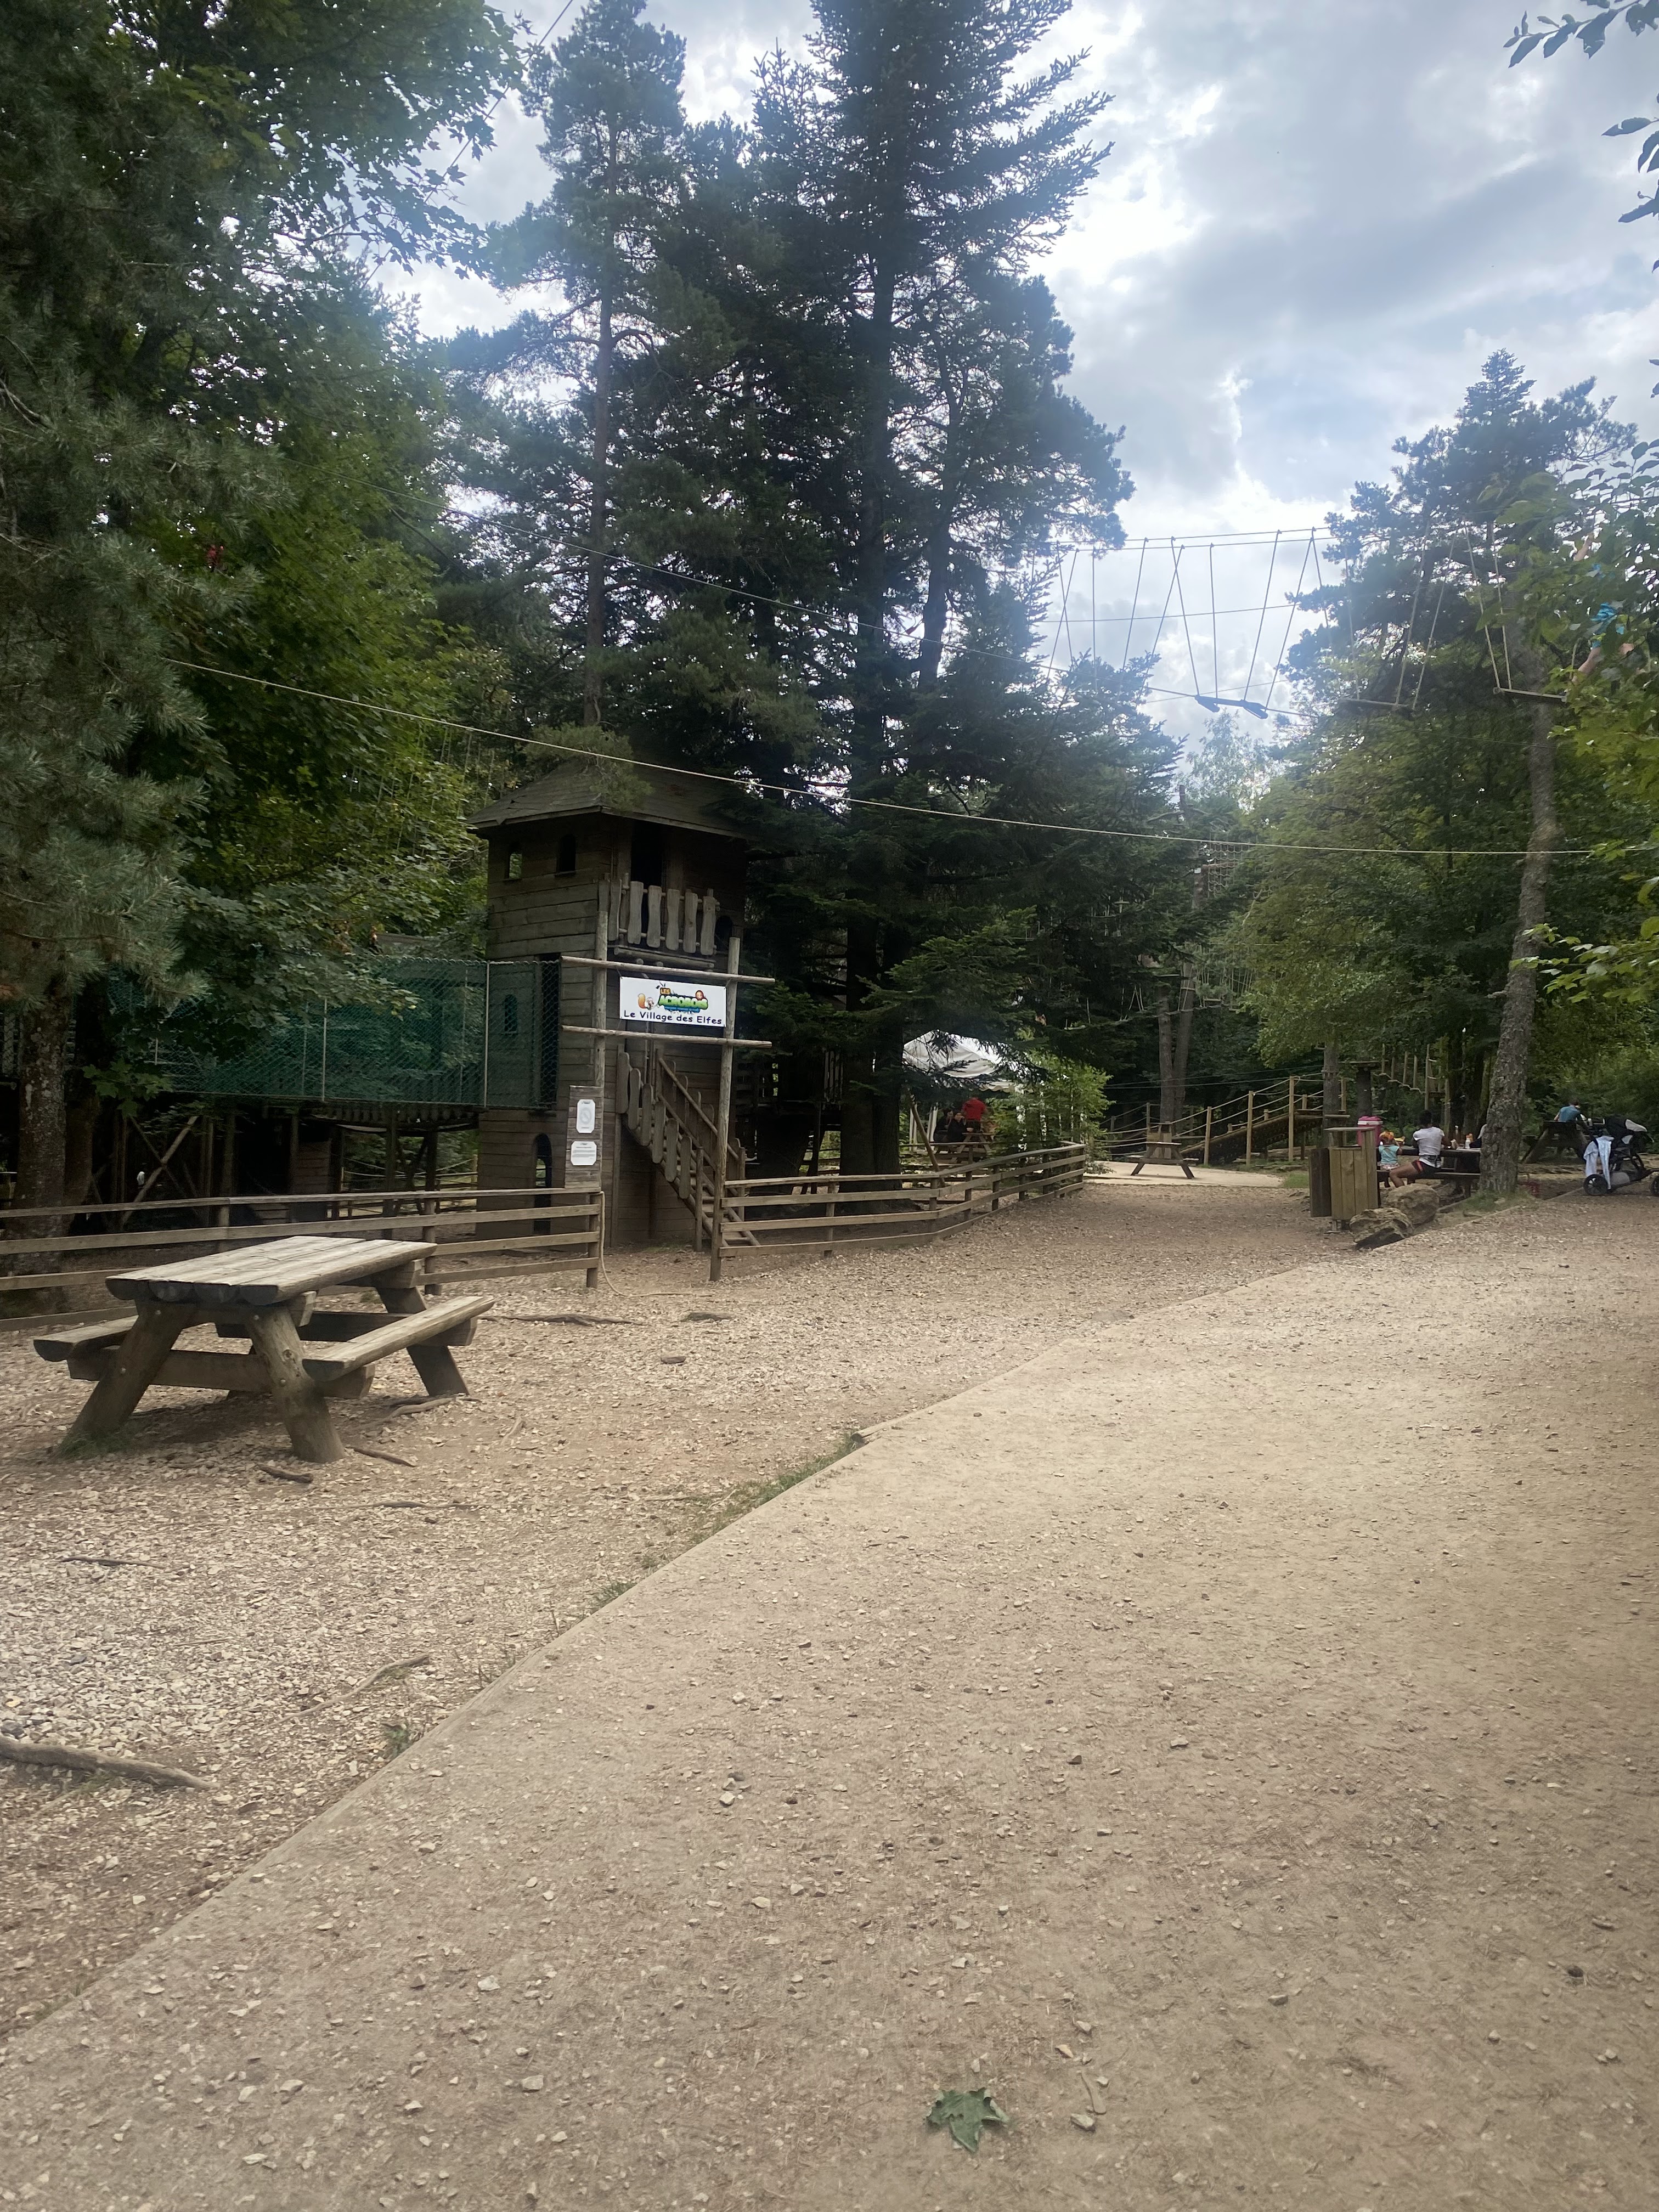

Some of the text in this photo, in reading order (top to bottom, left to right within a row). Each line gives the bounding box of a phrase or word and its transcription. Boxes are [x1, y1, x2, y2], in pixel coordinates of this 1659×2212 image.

[640, 1011, 673, 1022] Village
[676, 1014, 693, 1023] des
[697, 1015, 722, 1024] Elfes
